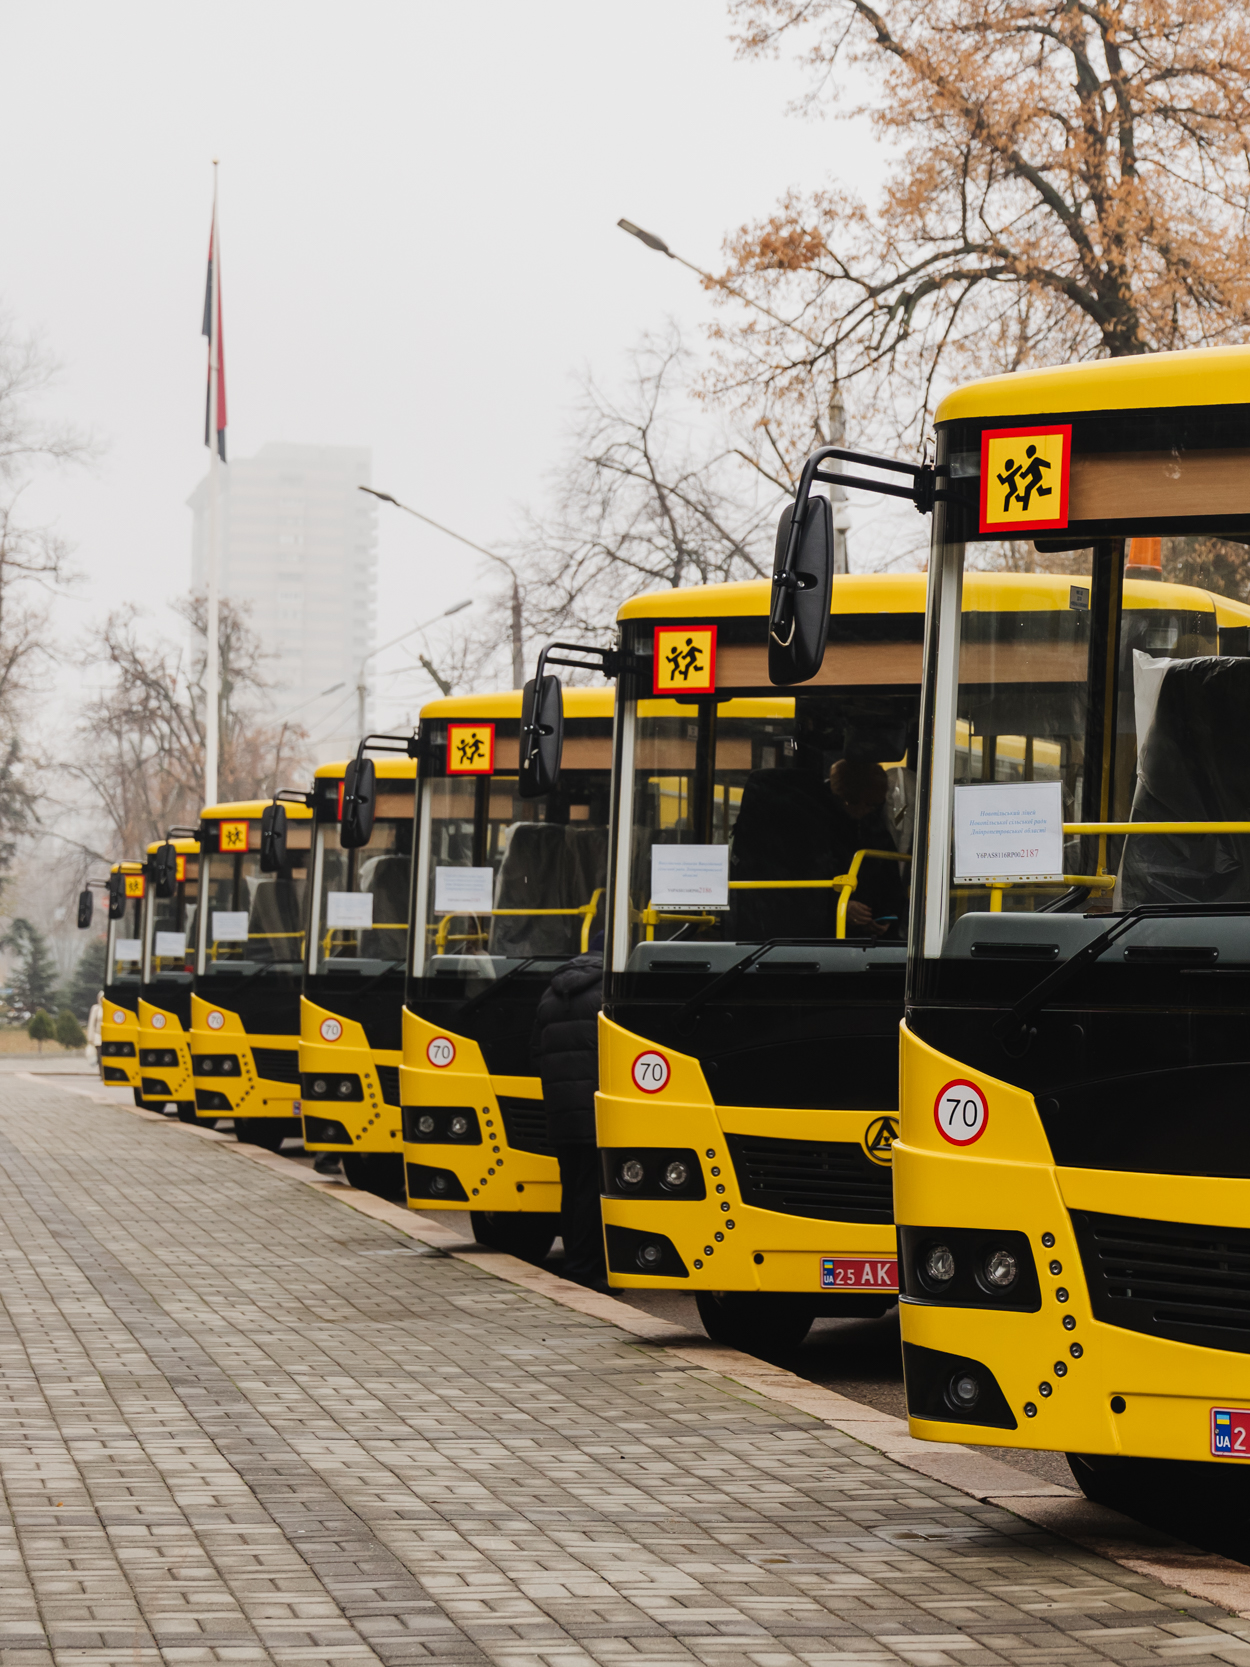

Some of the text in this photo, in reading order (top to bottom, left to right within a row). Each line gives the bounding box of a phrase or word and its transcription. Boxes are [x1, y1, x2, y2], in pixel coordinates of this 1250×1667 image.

[325, 1024, 339, 1036] 70
[433, 1045, 451, 1060] 70
[640, 1062, 663, 1082] 70
[946, 1098, 978, 1128] 70
[823, 1262, 892, 1285] UA 25 AK
[1216, 1435, 1231, 1448] UA
